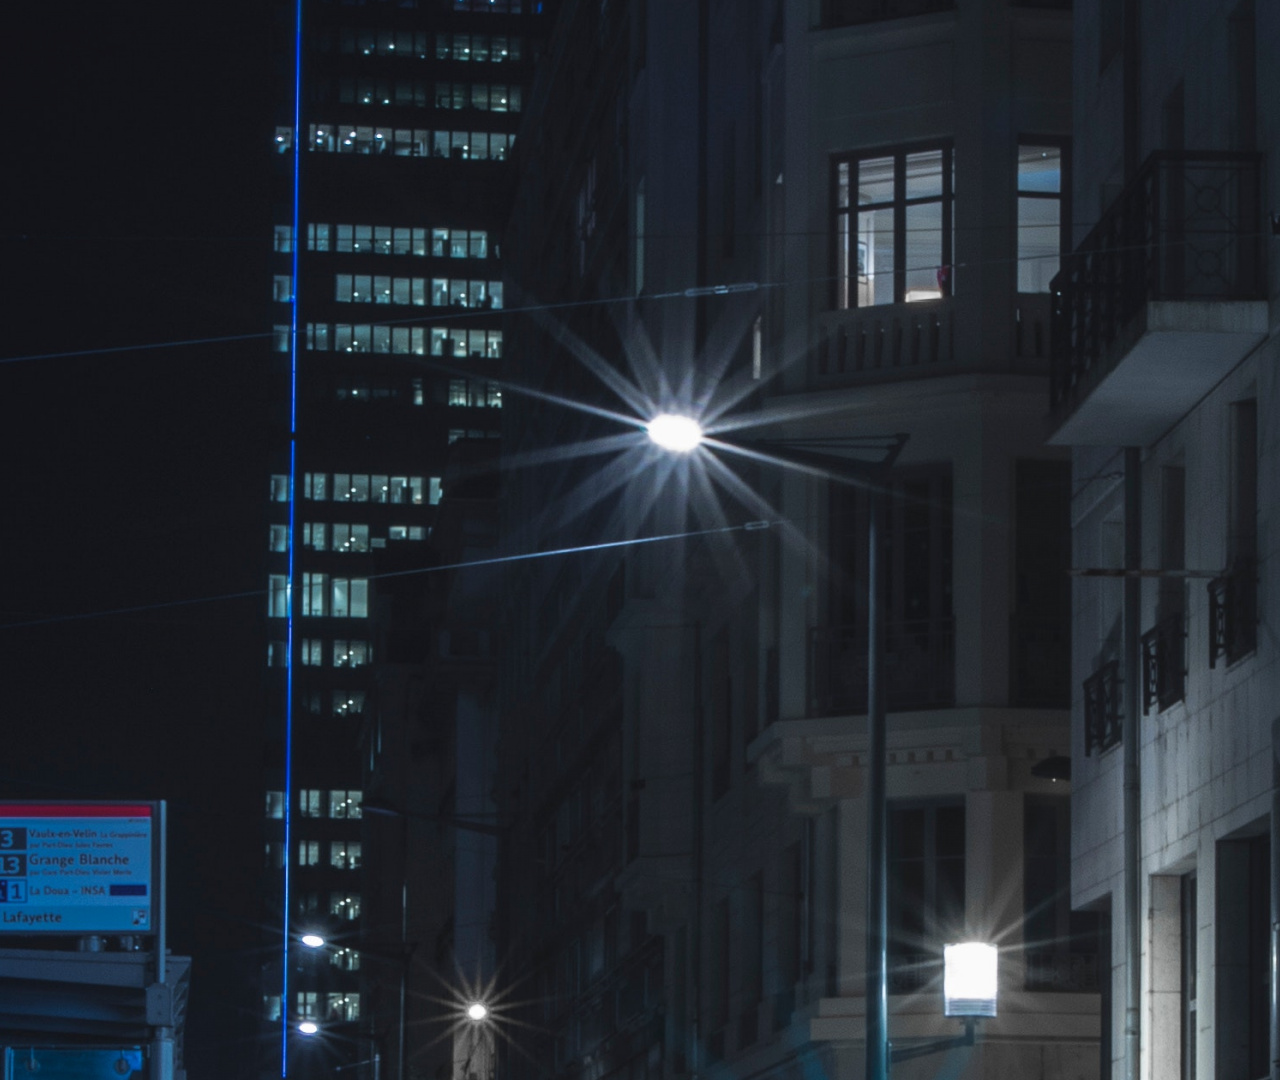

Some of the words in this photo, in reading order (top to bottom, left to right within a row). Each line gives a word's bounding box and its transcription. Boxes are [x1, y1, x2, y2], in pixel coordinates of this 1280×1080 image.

[1, 830, 14, 848] 3
[29, 829, 97, 838] Vaulx-en-Velin
[29, 853, 74, 868] Grange
[79, 853, 129, 865] Blanche
[29, 886, 40, 895] La
[43, 886, 69, 895] Doua
[81, 886, 105, 895] INSA
[3, 910, 61, 924] Lafayette
